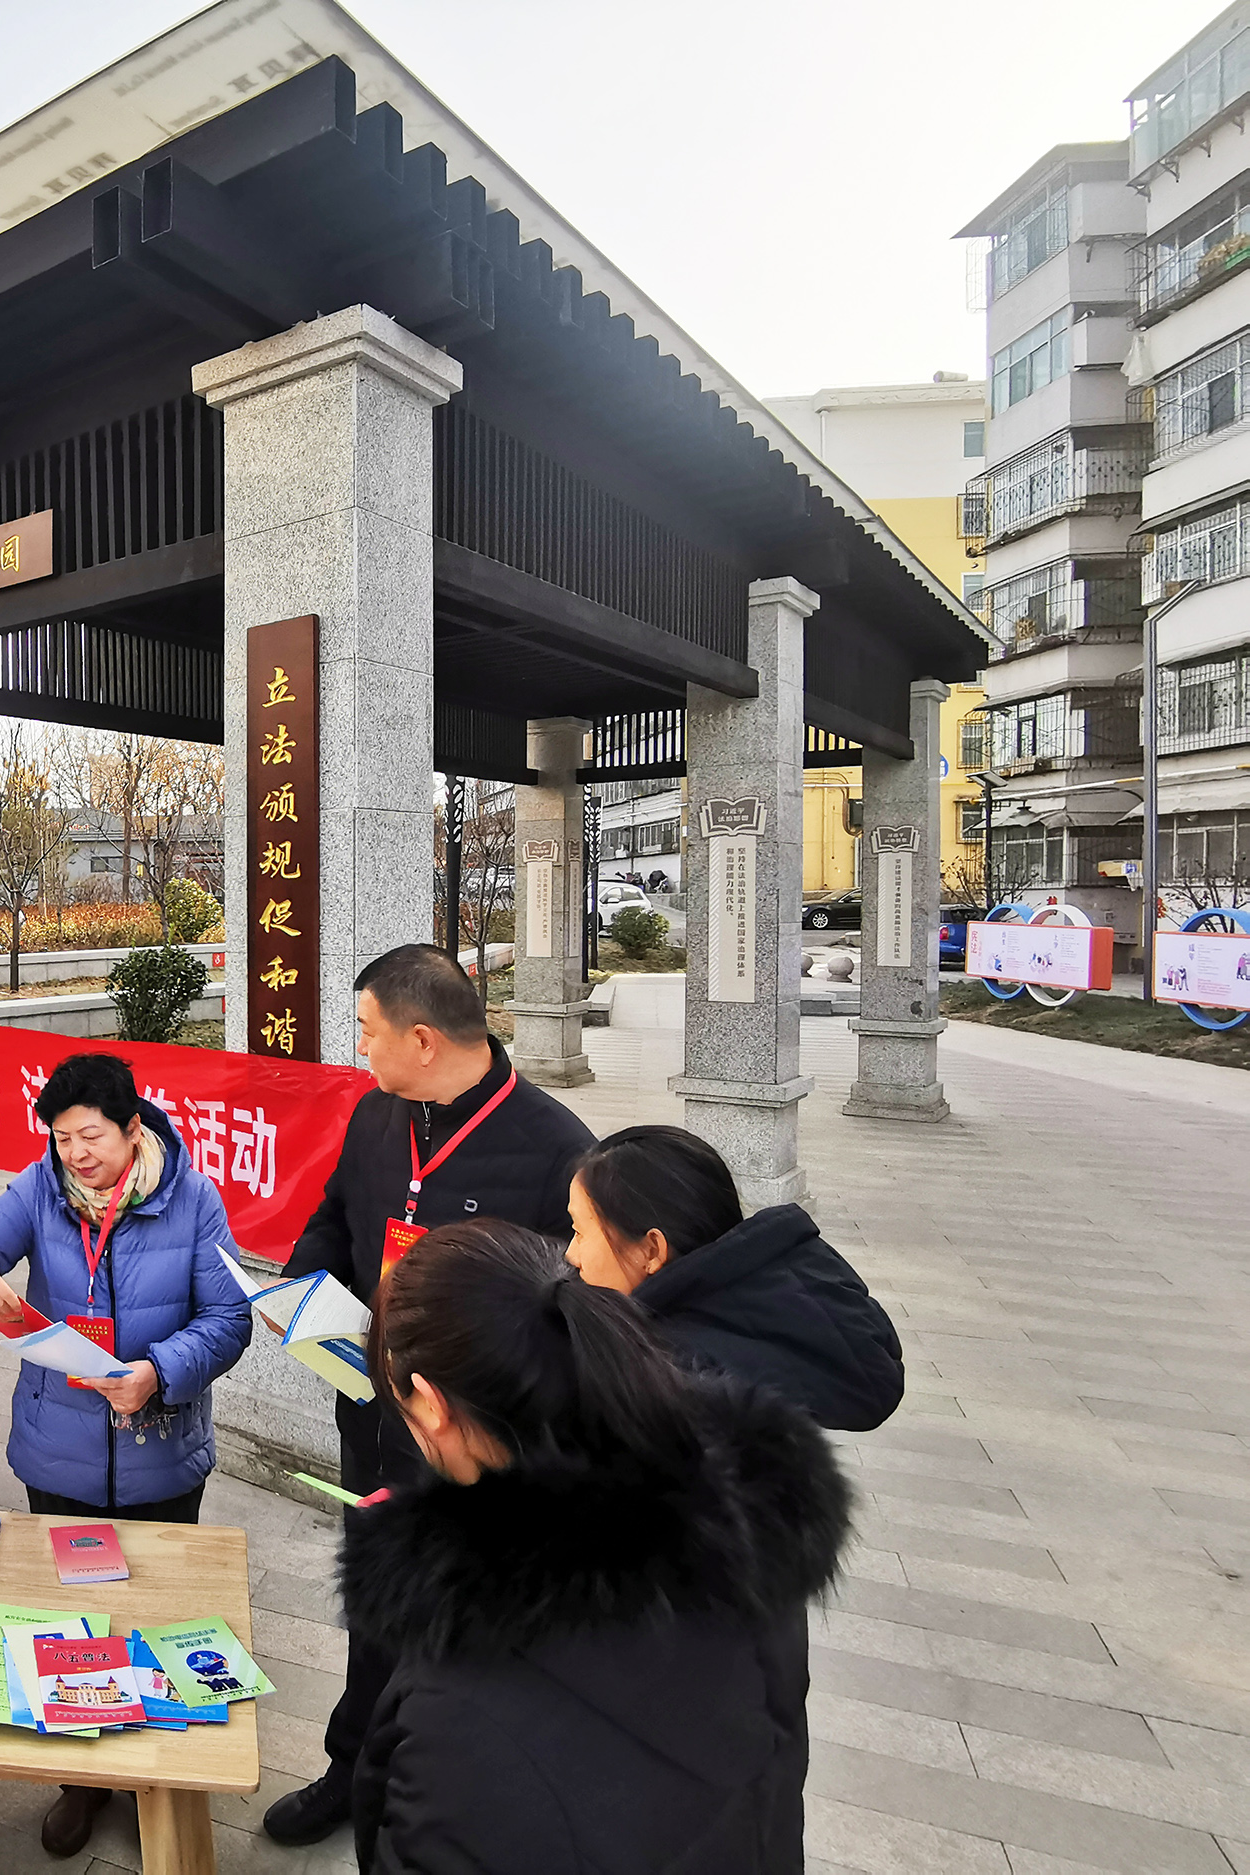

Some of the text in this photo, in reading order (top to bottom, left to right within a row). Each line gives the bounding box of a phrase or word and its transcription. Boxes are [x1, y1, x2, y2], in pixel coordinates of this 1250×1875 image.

[259, 666, 302, 1056] 立法颁规促和谐
[54, 1651, 111, 1663] 八五普法
